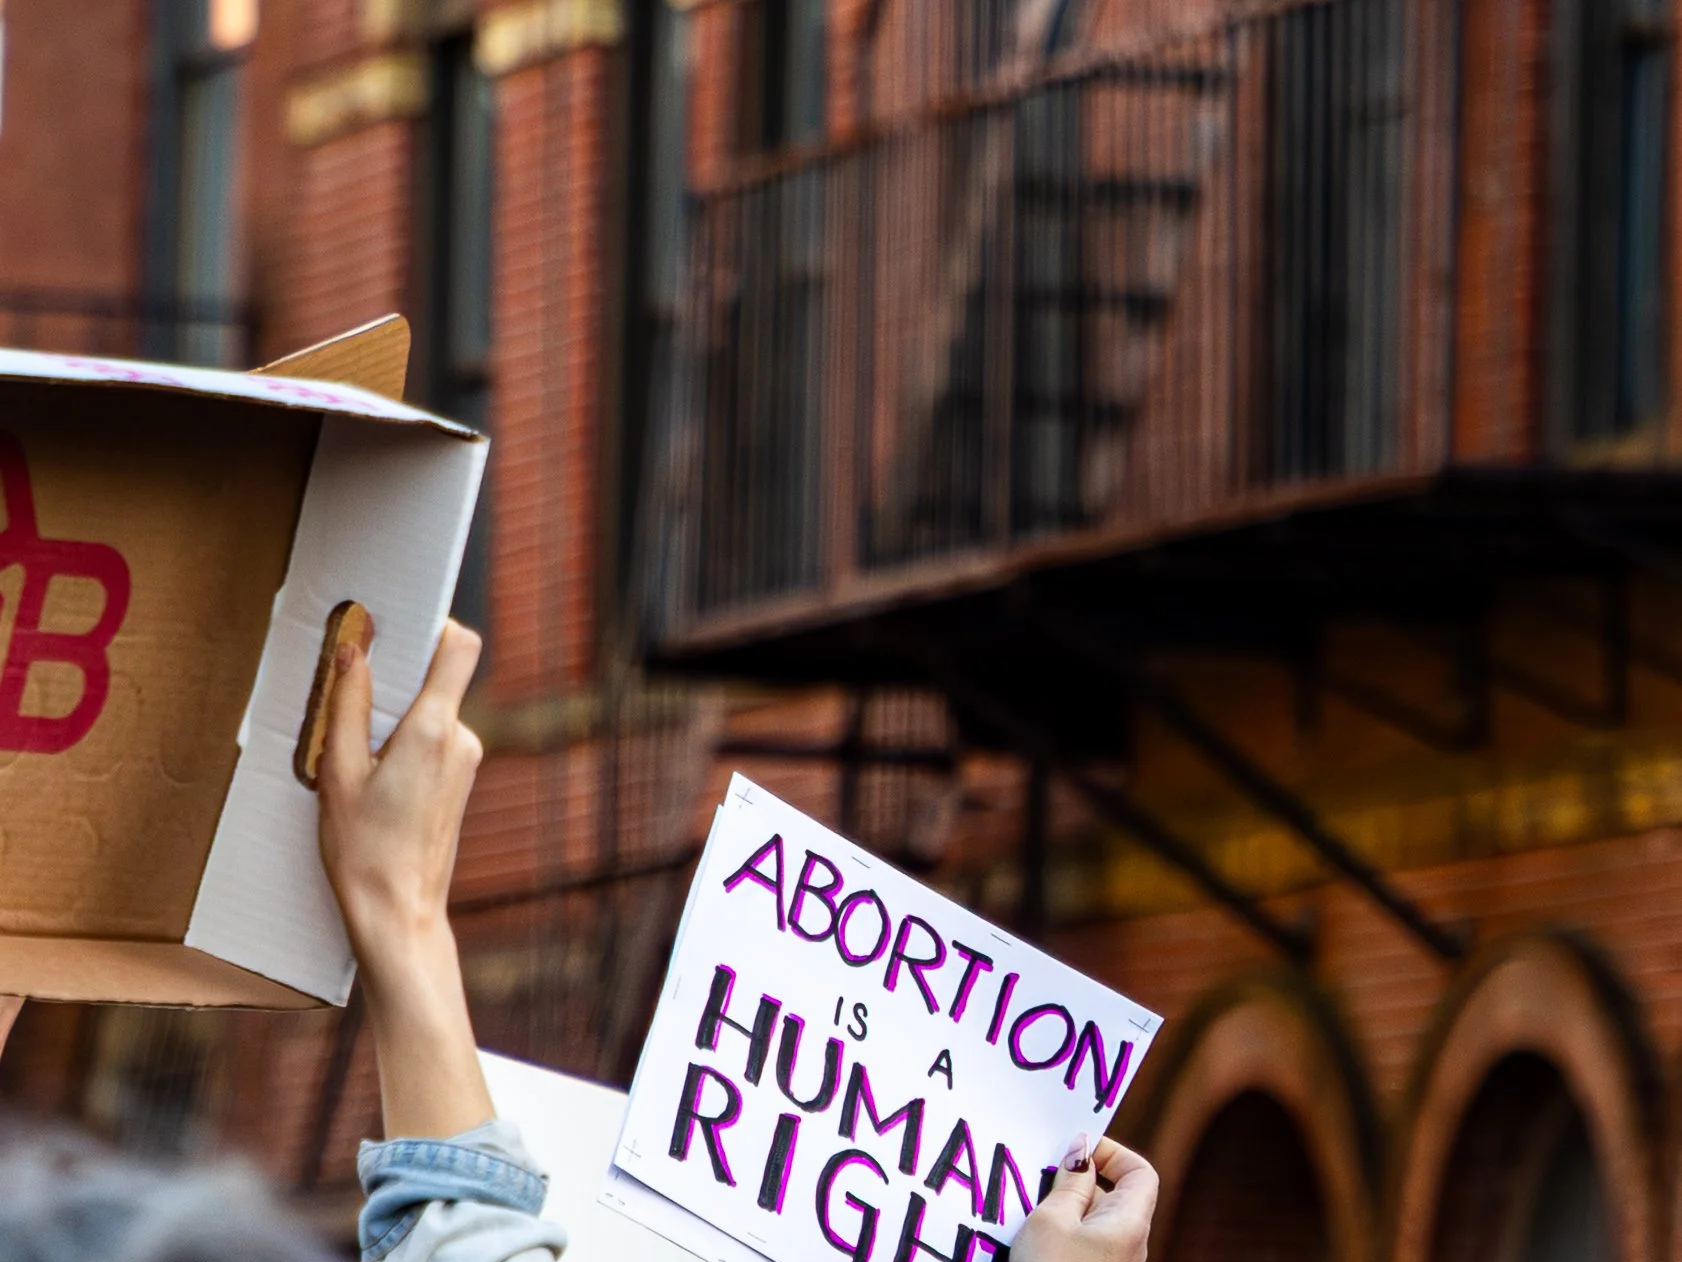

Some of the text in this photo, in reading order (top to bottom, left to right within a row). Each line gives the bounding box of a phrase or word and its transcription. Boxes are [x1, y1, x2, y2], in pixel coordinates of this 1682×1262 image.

[694, 963, 1057, 1227] HUMAN
[723, 833, 1134, 1114] ABORTION
[834, 995, 953, 1090] IS A
